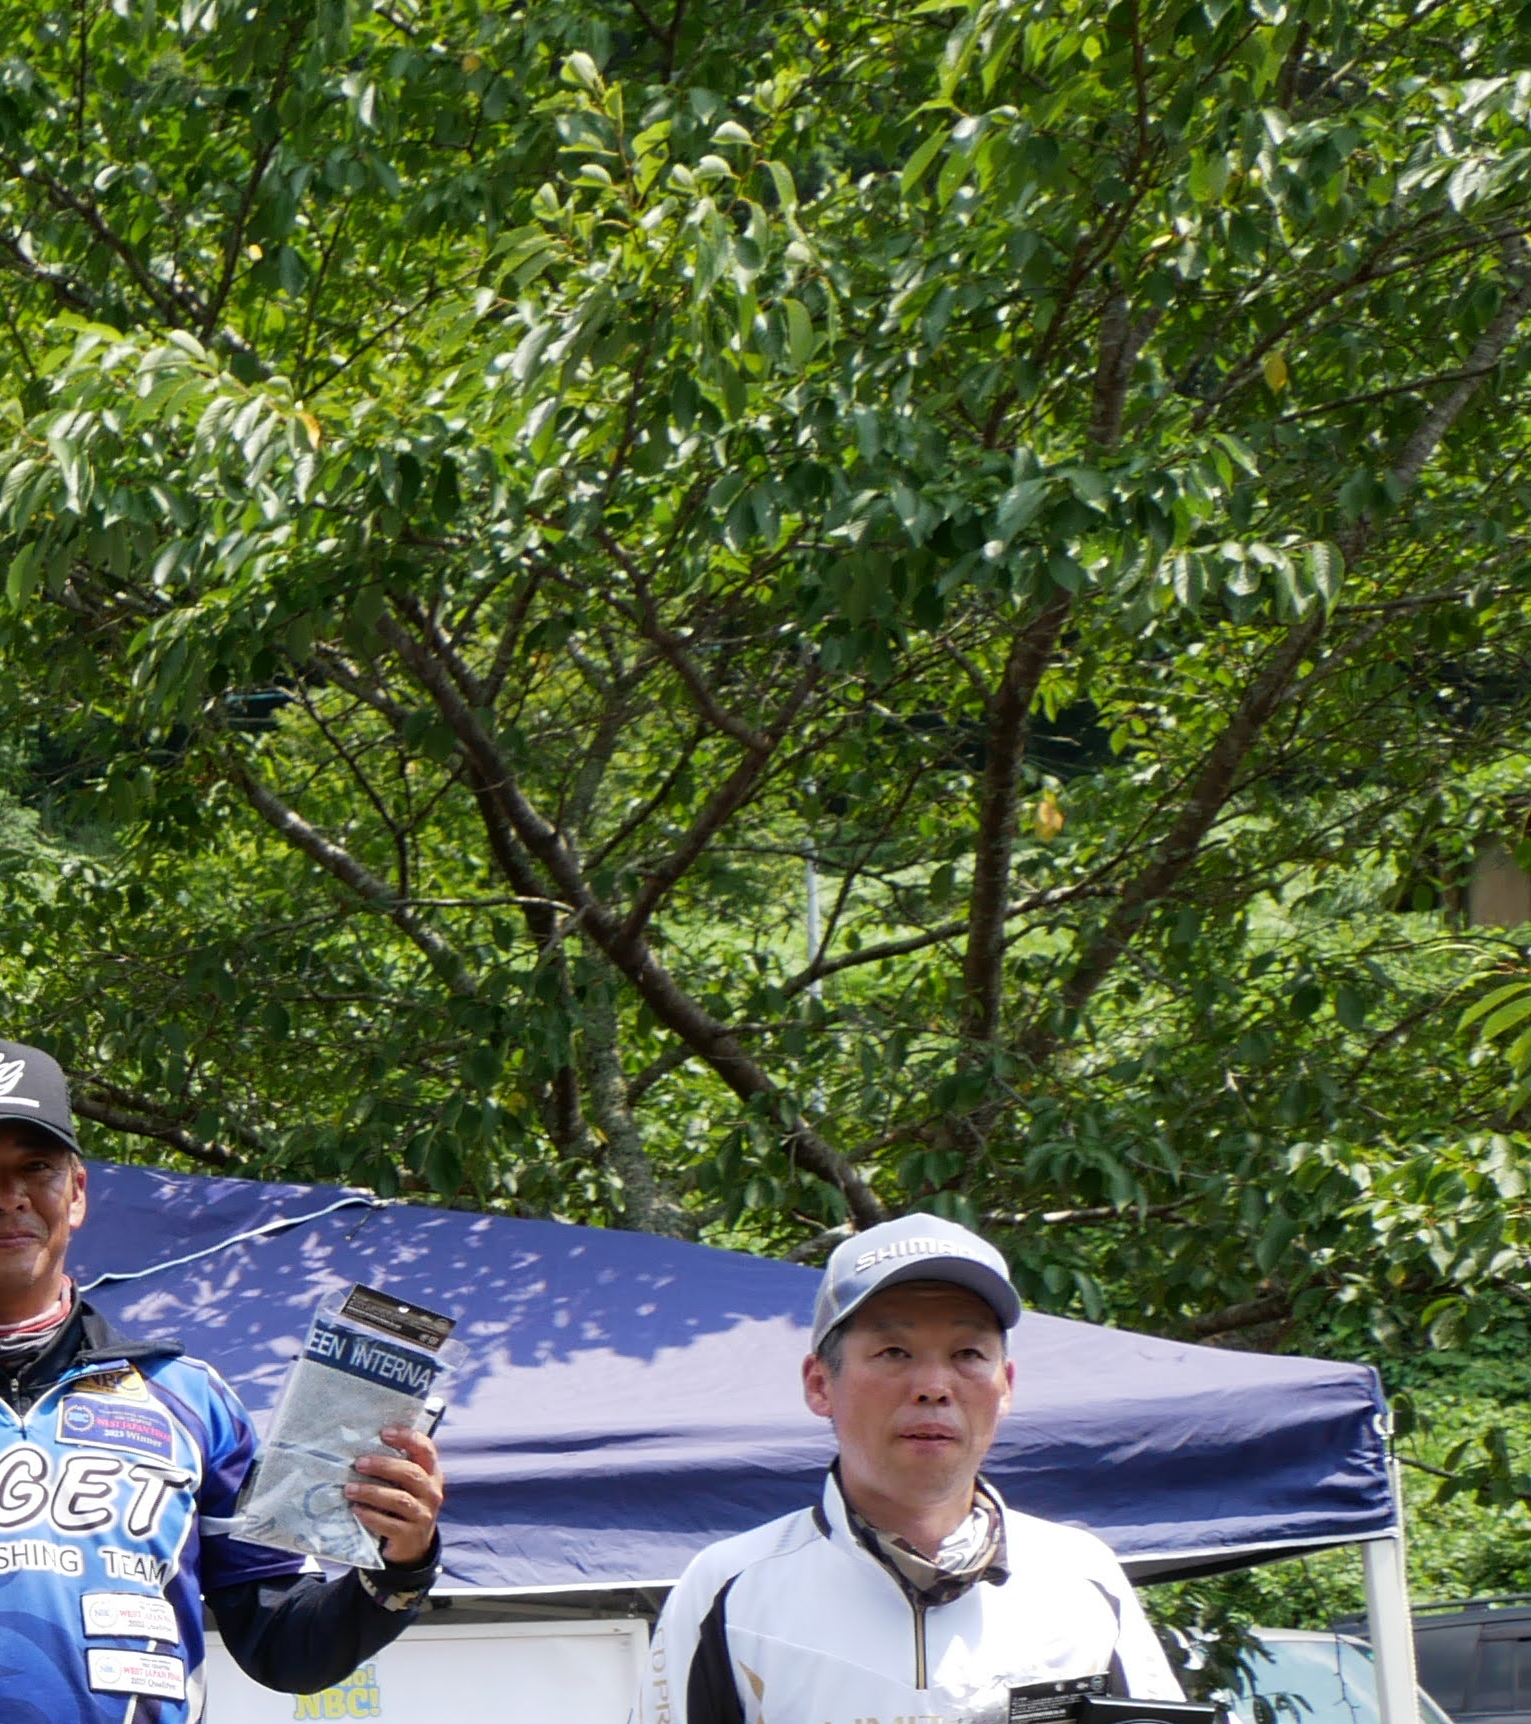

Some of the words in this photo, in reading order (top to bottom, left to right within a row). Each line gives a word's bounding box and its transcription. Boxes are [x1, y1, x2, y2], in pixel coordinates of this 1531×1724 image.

[306, 1331, 346, 1360] EEN
[349, 1343, 433, 1393] INTERNA
[102, 1550, 167, 1584] TEAM
[293, 1687, 381, 1720] NBC!
